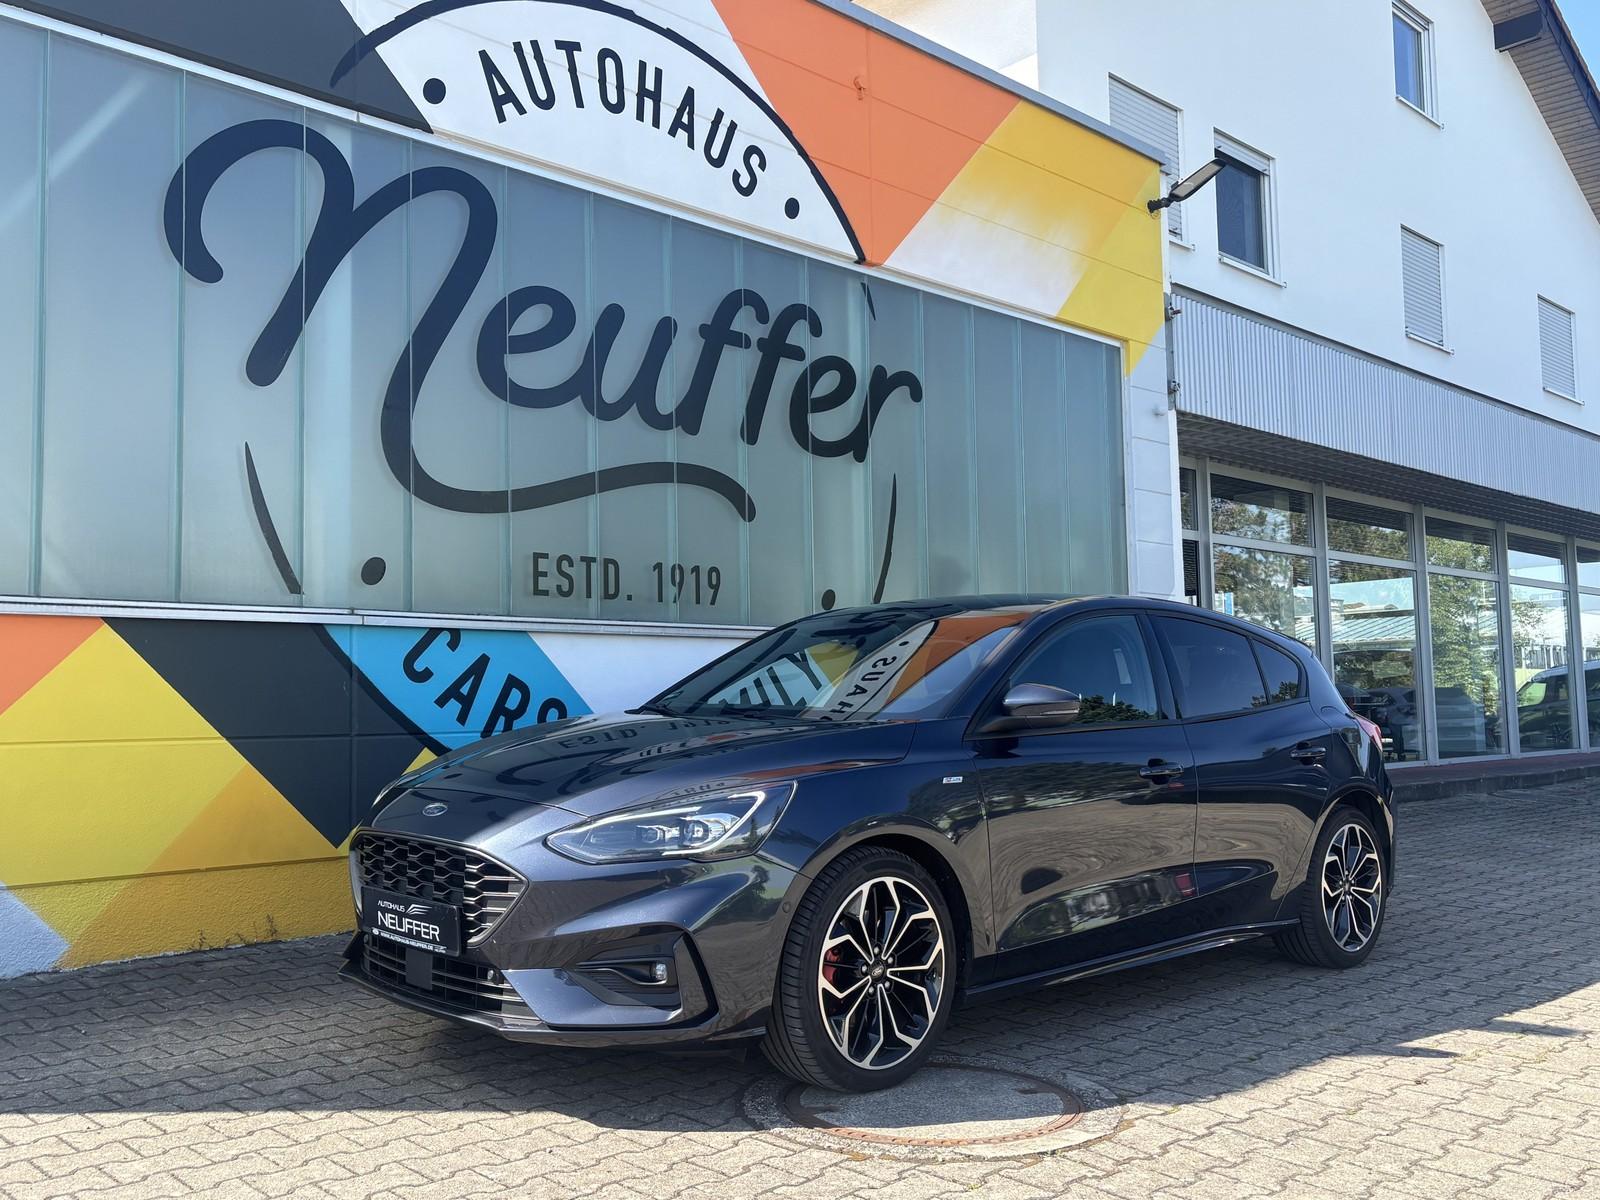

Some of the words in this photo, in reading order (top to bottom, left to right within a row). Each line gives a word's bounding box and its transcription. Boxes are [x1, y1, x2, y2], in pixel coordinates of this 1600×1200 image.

[478, 39, 767, 197] AUTOHAUS
[532, 552, 633, 601] ESTD.
[652, 562, 721, 605] 1919
[377, 900, 406, 913] AUTOHAUS
[377, 910, 440, 942] NEUFFER
